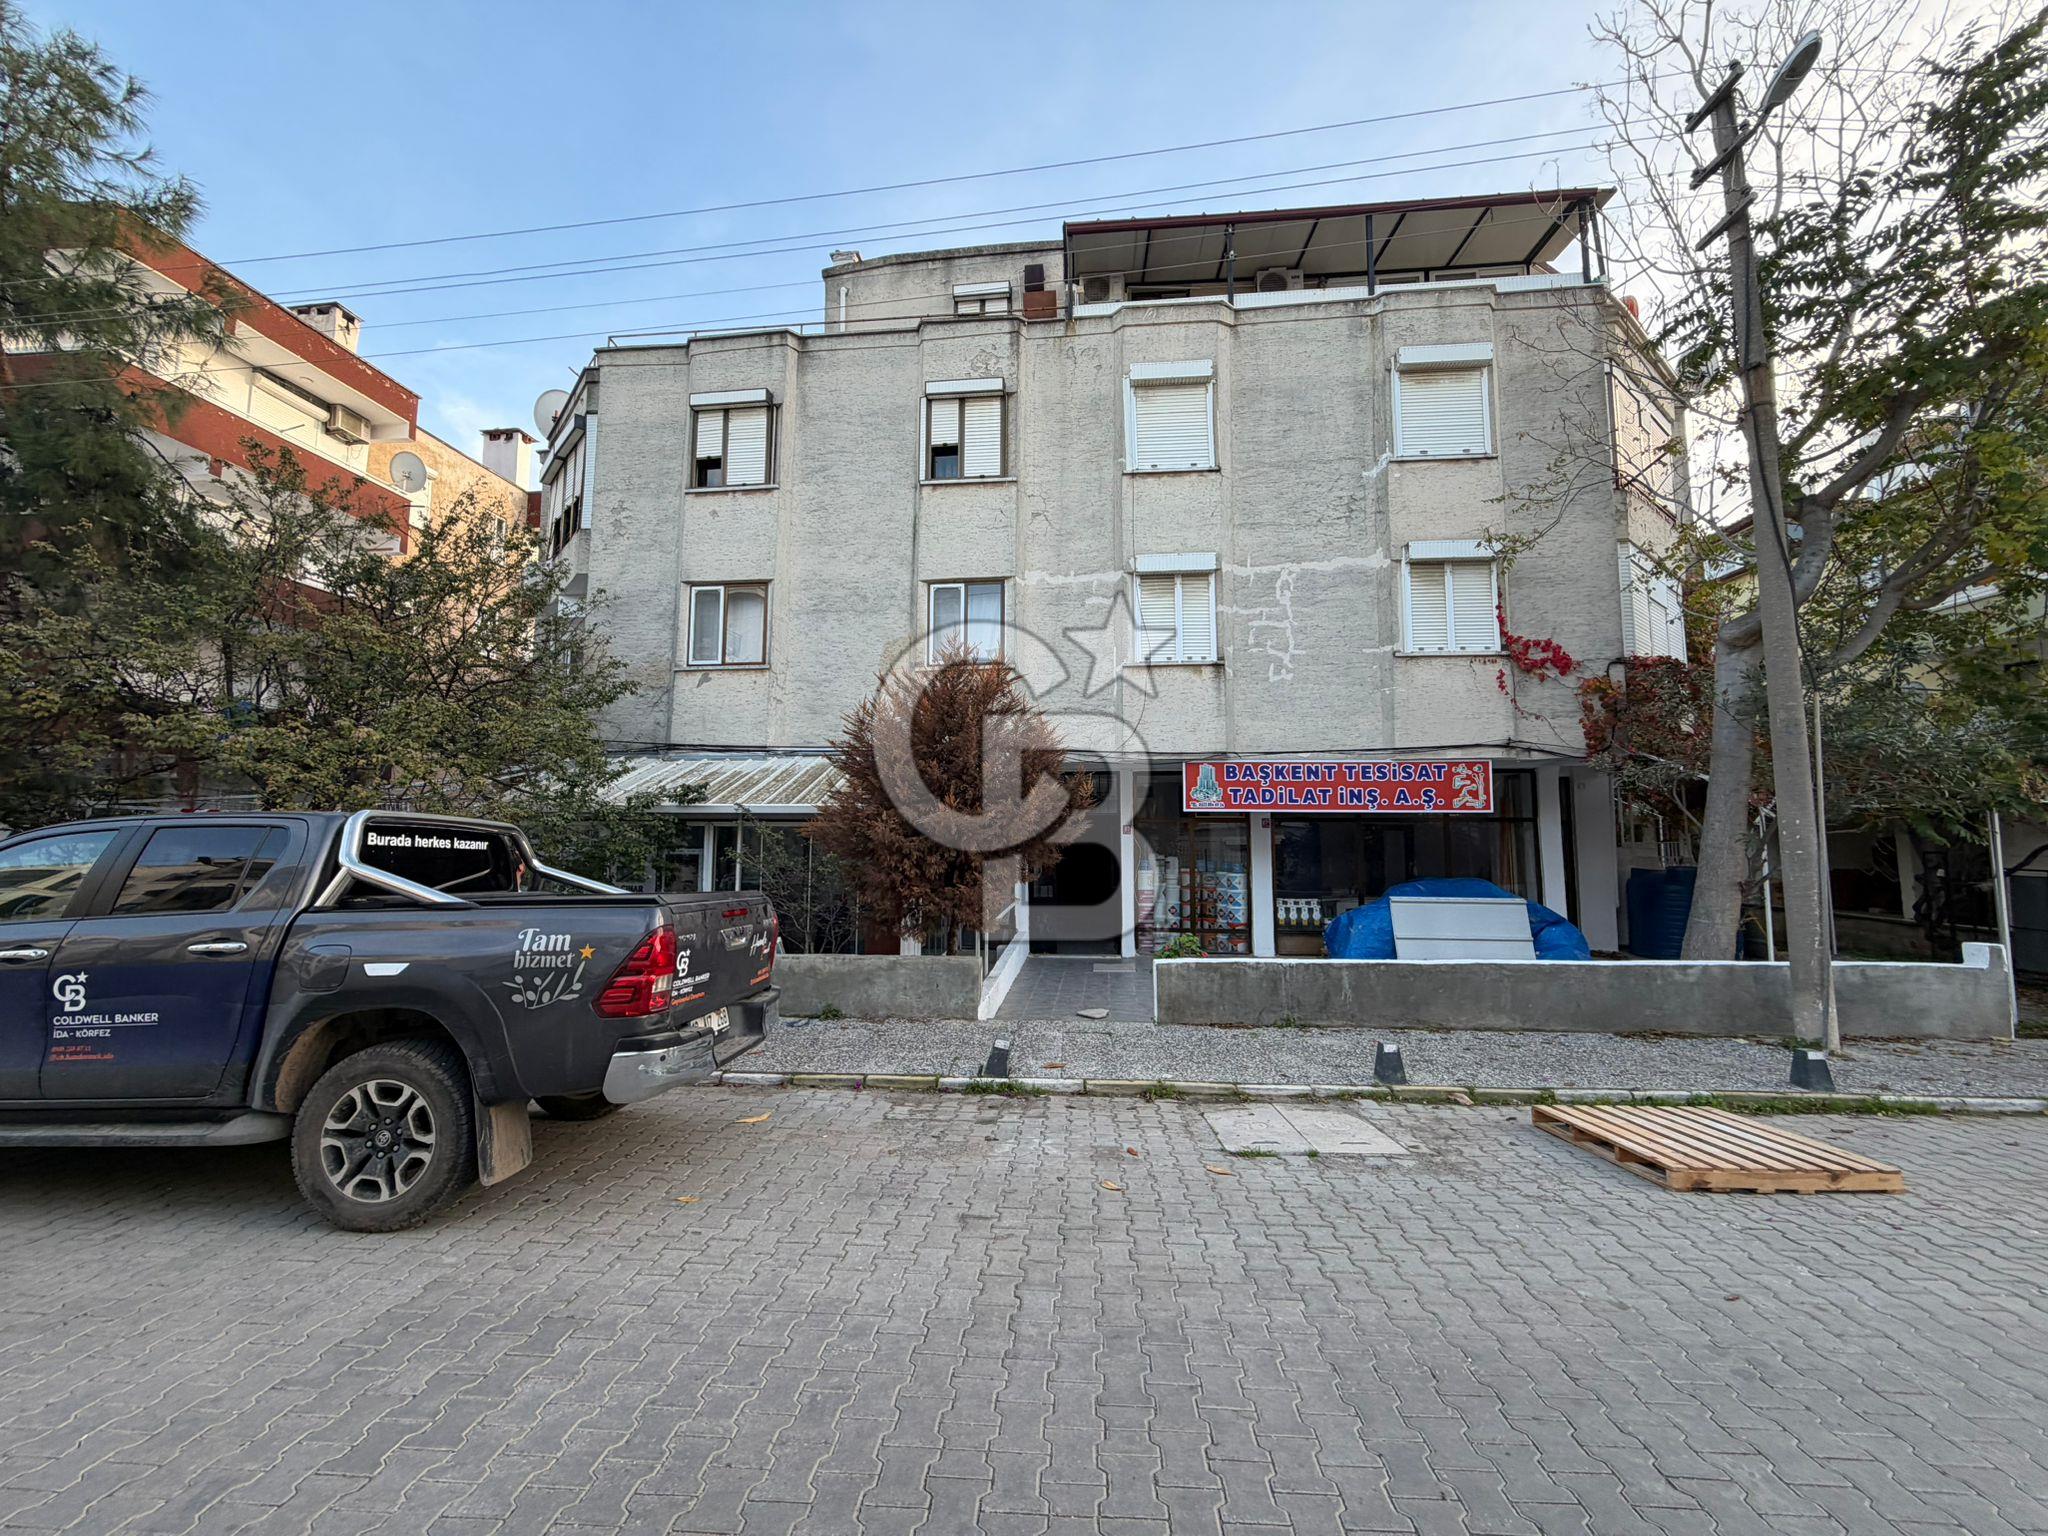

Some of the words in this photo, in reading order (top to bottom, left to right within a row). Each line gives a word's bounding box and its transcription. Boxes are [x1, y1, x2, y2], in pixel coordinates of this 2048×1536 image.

[1224, 763, 1337, 786] BAŞKENT
[1394, 787, 1445, 811] A.Ş.
[367, 832, 412, 847] Burada
[414, 835, 451, 849] herkes
[453, 837, 489, 850] kazanır
[518, 928, 572, 952] Tam
[513, 950, 576, 970] hizmet
[53, 1014, 112, 1026] COLDWELL
[115, 1012, 158, 1023] BANKER
[53, 1028, 69, 1039] İDA
[75, 1028, 112, 1038] KÖRFEZ
